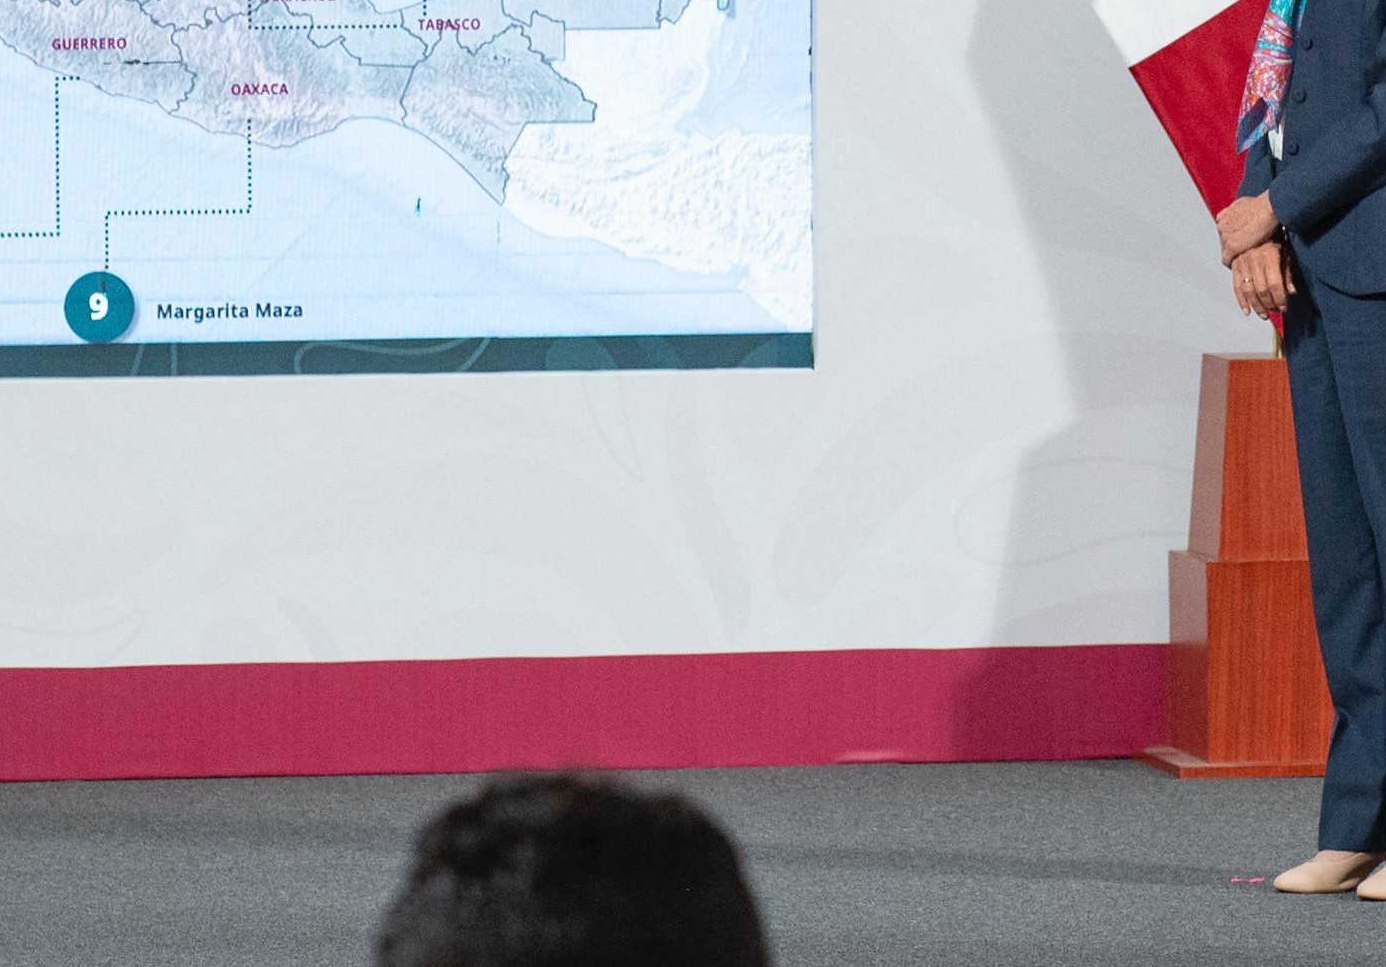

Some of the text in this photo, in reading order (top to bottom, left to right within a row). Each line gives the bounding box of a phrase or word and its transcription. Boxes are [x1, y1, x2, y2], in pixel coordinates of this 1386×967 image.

[418, 17, 481, 32] TABASCO
[52, 36, 127, 52] GUERRERO
[231, 82, 289, 97] OAXACA
[88, 293, 108, 322] 9
[156, 300, 303, 325] Margarita Maza
